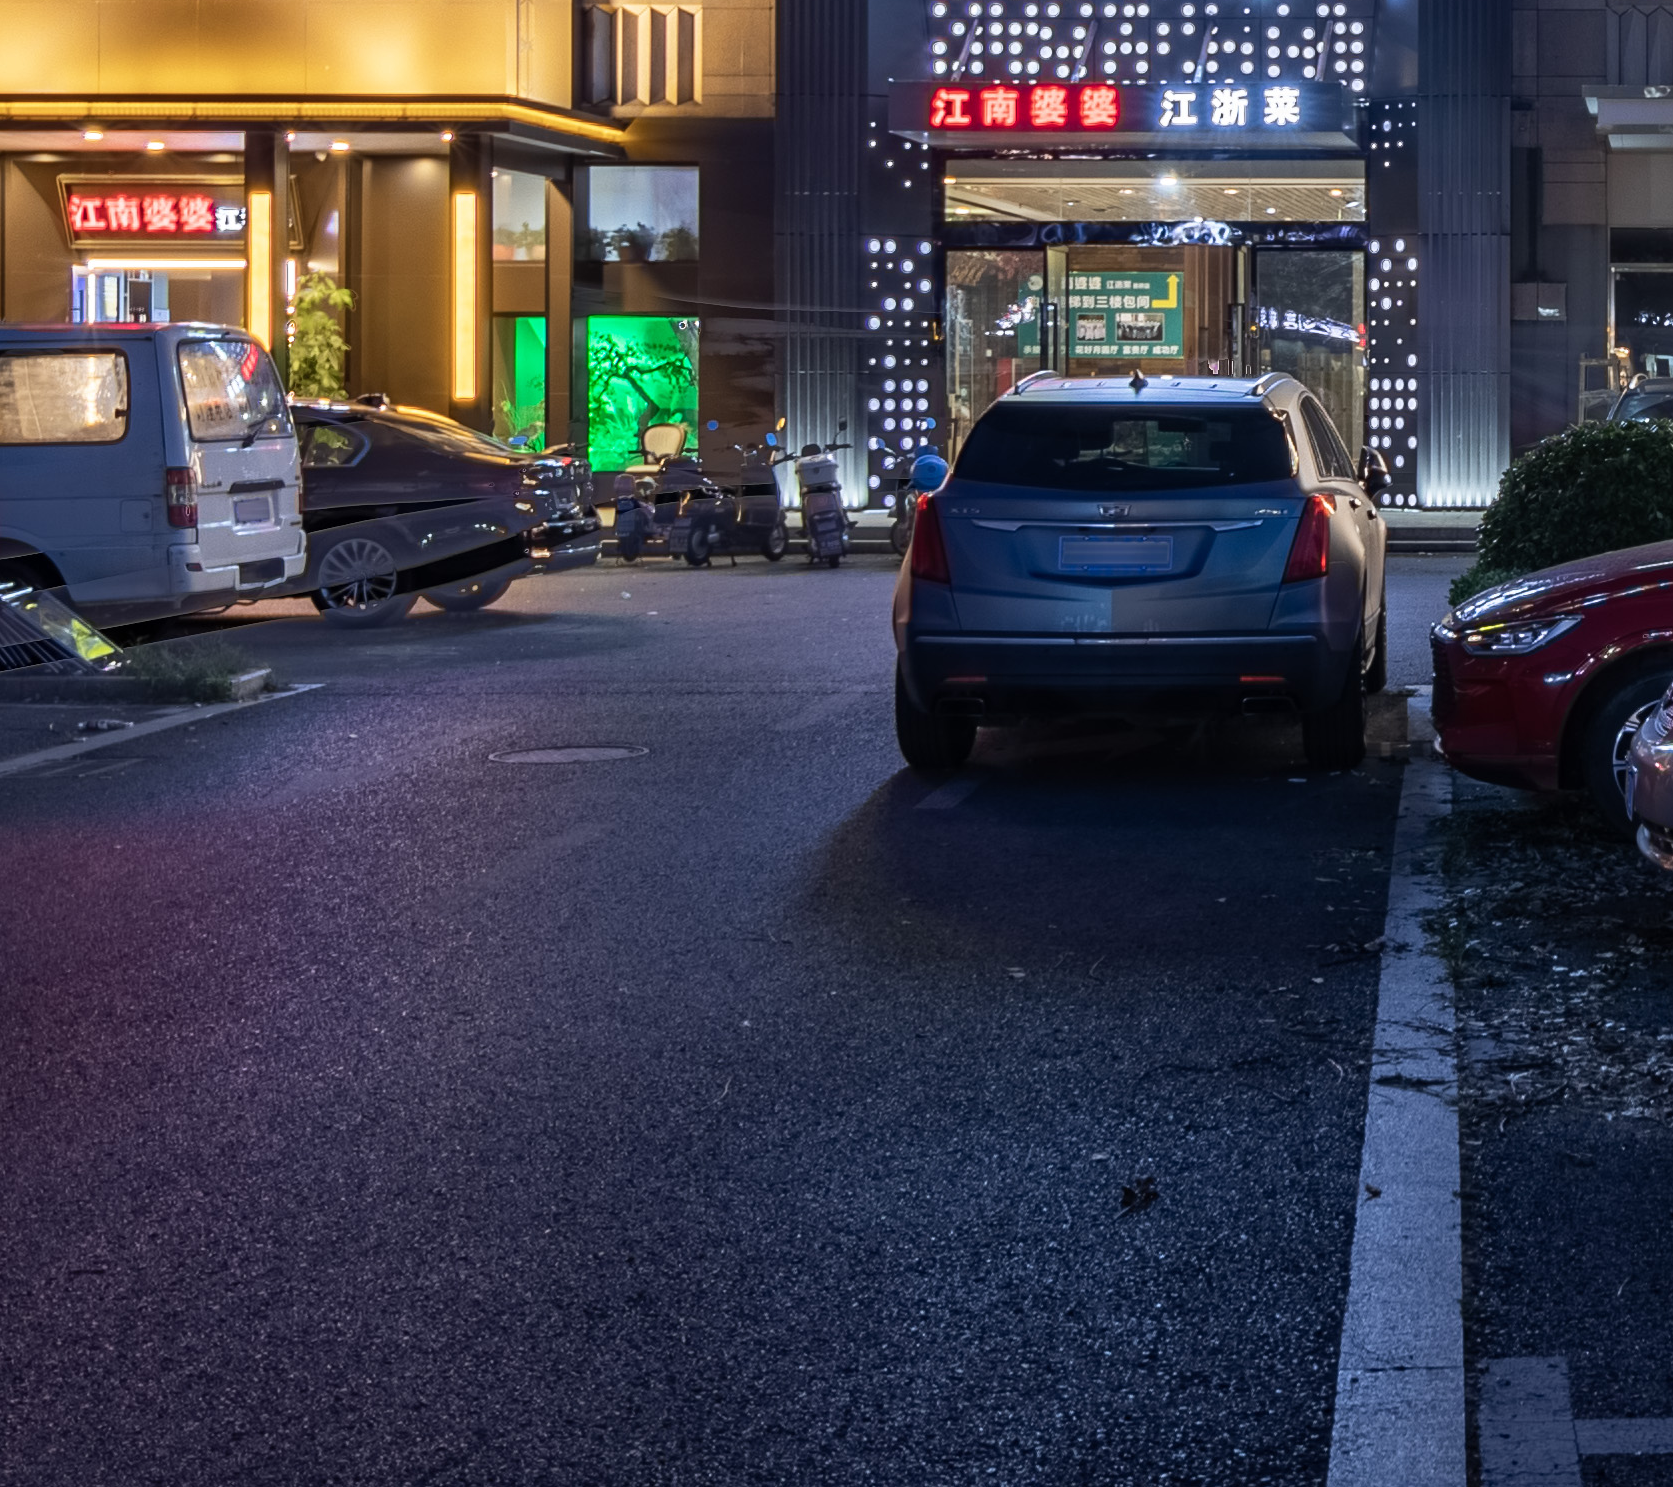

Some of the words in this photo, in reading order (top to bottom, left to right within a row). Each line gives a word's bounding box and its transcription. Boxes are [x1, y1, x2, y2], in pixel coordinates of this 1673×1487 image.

[929, 84, 1120, 128] 江南婆婆
[1159, 86, 1300, 127] 江浙菜
[68, 193, 214, 233] 江南婆婆
[215, 206, 246, 232] 江
